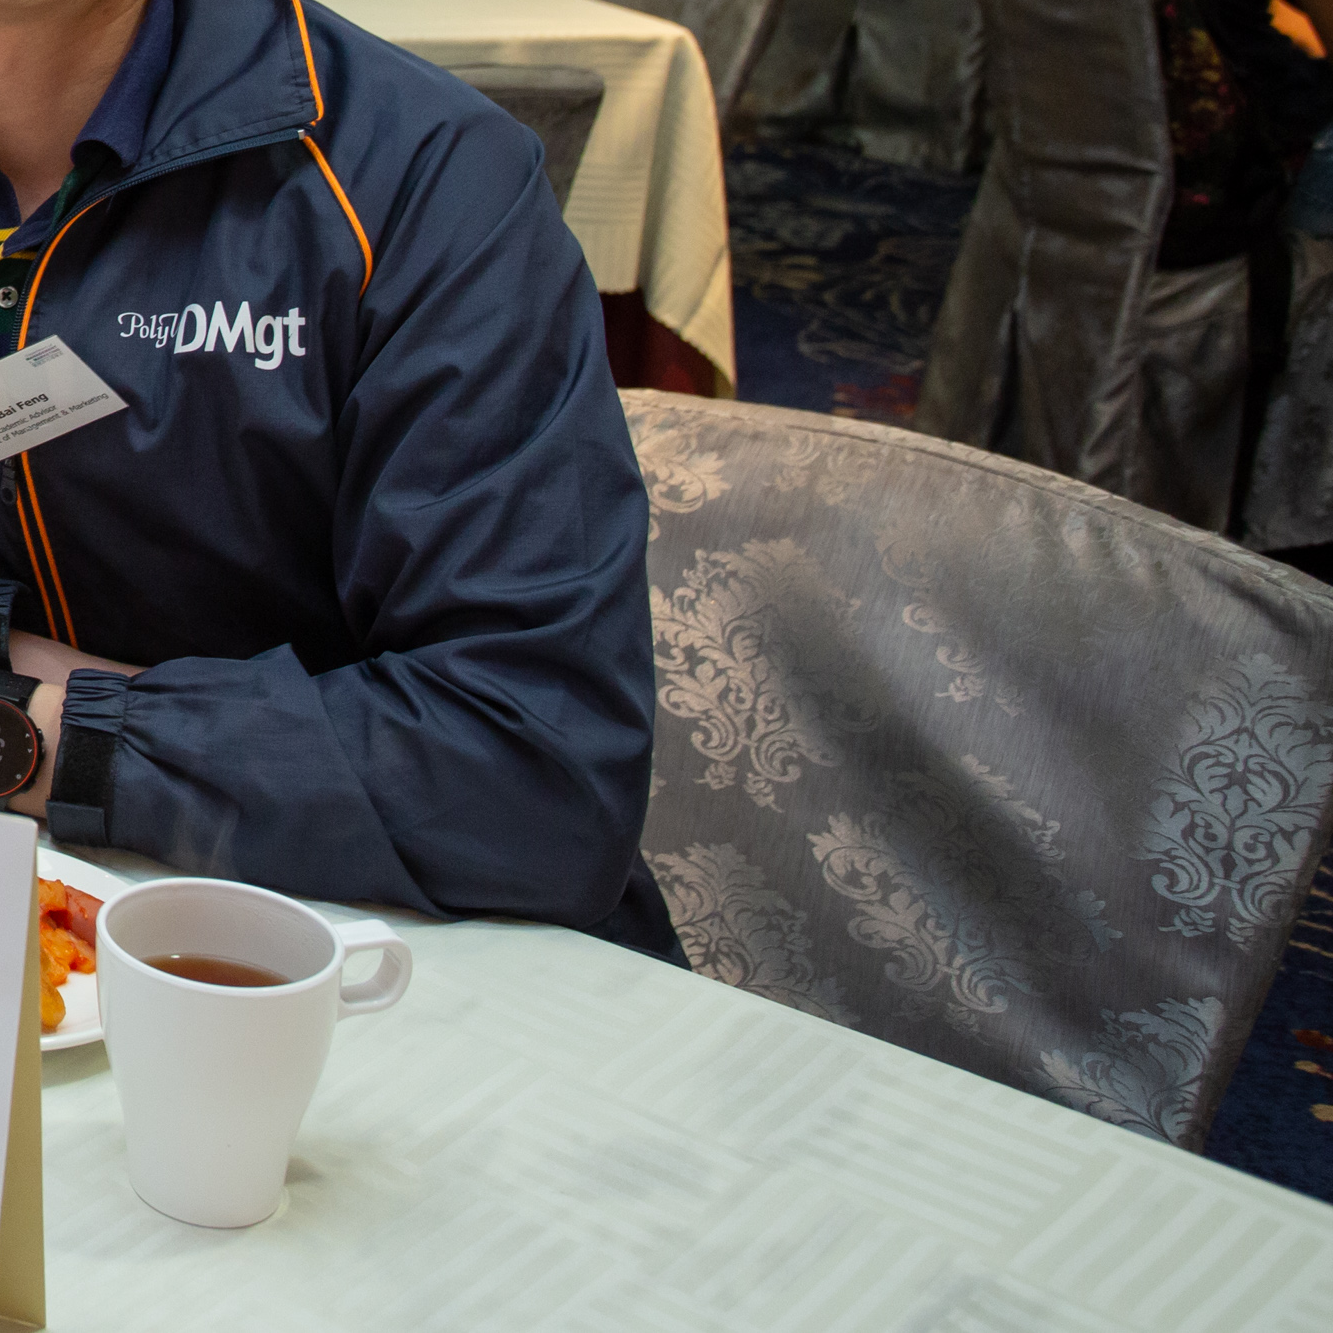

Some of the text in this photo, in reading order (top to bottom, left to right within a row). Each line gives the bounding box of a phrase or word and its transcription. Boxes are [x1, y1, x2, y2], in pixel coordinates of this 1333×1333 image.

[16, 392, 49, 410] Feng
[2, 433, 10, 442] of
[11, 412, 63, 437] Management
[69, 392, 109, 413] Marketing
[29, 404, 57, 420] Advisor
